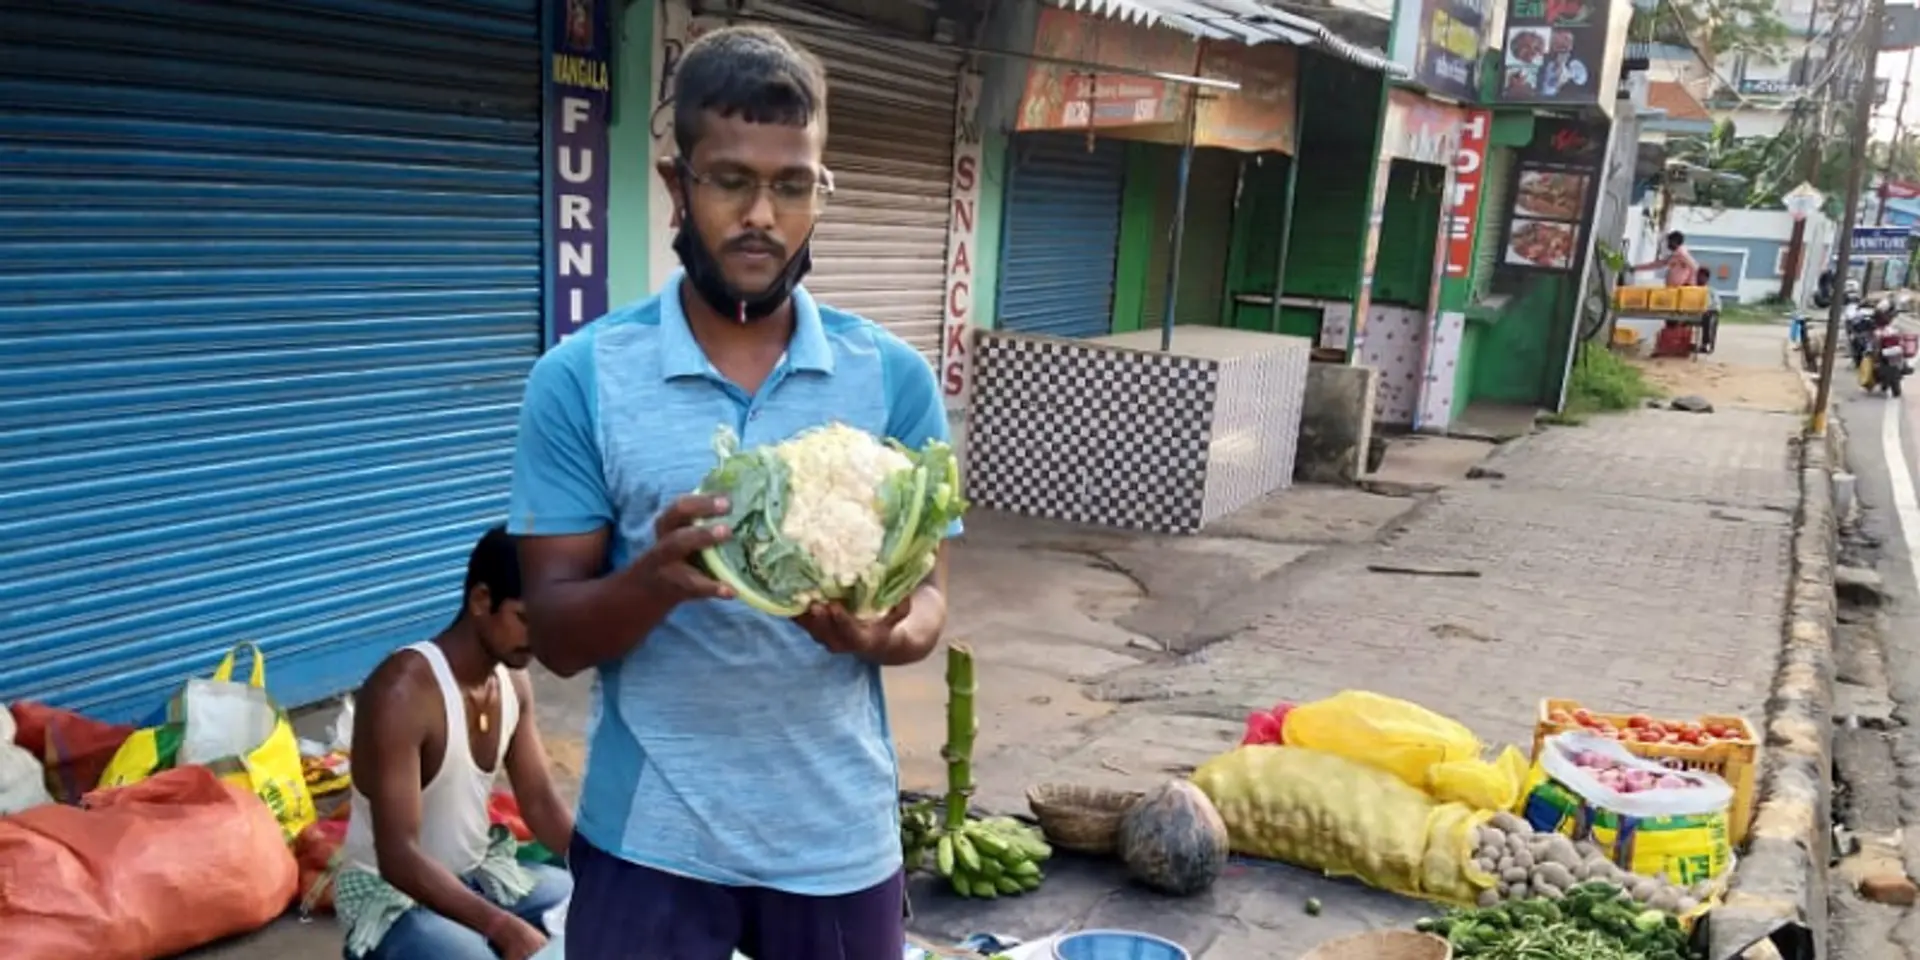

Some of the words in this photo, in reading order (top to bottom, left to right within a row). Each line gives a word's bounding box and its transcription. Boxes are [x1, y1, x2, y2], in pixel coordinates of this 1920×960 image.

[558, 97, 593, 341] FURNI
[944, 156, 976, 395] SNACKS
[1850, 236, 1906, 249] URNITURE
